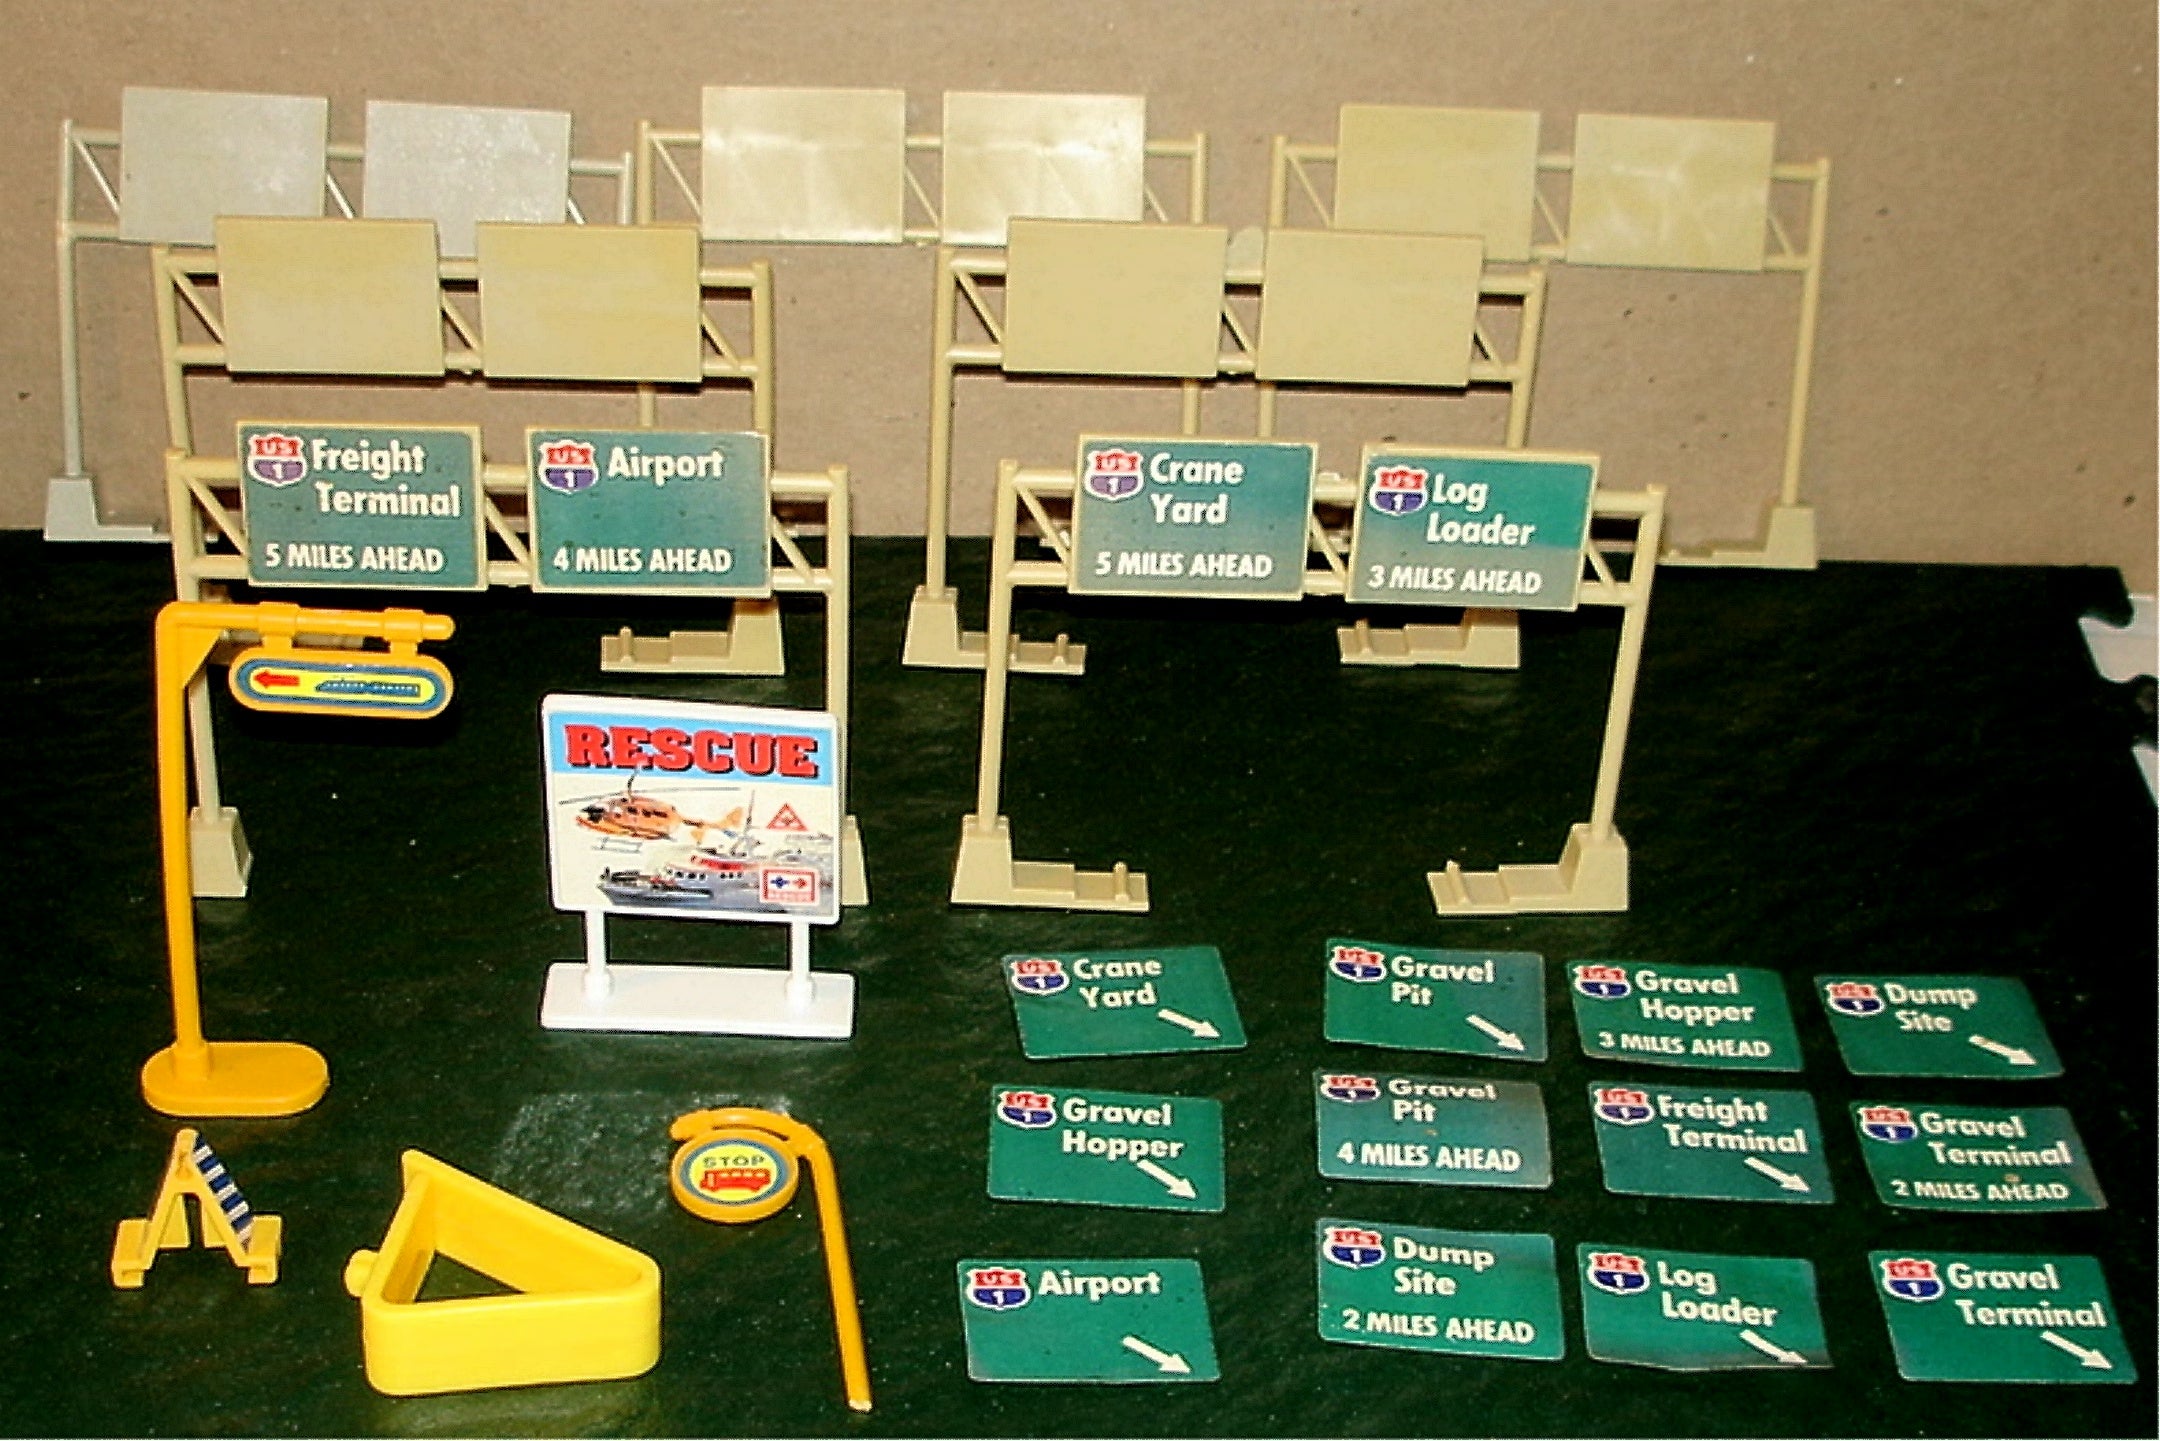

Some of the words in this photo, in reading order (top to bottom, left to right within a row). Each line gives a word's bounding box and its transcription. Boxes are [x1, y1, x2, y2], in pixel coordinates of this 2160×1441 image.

[312, 440, 427, 481] Freight
[608, 447, 724, 486] Airport
[1149, 454, 1243, 486] Crane
[316, 482, 460, 518] Terminal
[1432, 474, 1488, 512] Log
[1151, 493, 1228, 525] Yard
[1427, 514, 1535, 545] Loader
[266, 543, 281, 567] 5
[288, 545, 353, 569] MILES
[360, 548, 444, 572] AHEAD
[553, 549, 572, 570] 4
[577, 549, 642, 570] MILES
[650, 550, 732, 573] AHEAD
[1095, 551, 1111, 575] 5
[1118, 551, 1182, 577] MILES
[1188, 553, 1272, 578] AHEAD
[1369, 564, 1385, 588] 3
[1391, 566, 1454, 591] MILES
[1461, 570, 1541, 593] AHEAD
[564, 724, 819, 779] RESCUE
[1073, 958, 1162, 979] Crane
[1391, 955, 1496, 983] Gravel
[1635, 971, 1738, 994] Gravel
[1080, 983, 1156, 1008] Yard
[1391, 983, 1433, 1006] Pit
[1884, 983, 1978, 1008] Dump
[1641, 999, 1755, 1026] Hopper
[1896, 1010, 1953, 1032] Site
[1599, 1032, 1614, 1049] 3
[1621, 1033, 1686, 1054] MILES
[1692, 1039, 1770, 1058] AHEAD
[1389, 1080, 1497, 1100] Gravel
[1063, 1099, 1172, 1127] Gravel
[1393, 1100, 1436, 1122] Pit
[1658, 1095, 1767, 1127] Freight
[1661, 1123, 1808, 1154] Terminal
[1921, 1113, 2026, 1138] Gravel
[1062, 1130, 1184, 1161] Hopper
[1337, 1144, 1355, 1162] 4
[1362, 1145, 1429, 1167] MILES
[1436, 1147, 1521, 1170] AHEAD
[1928, 1141, 2072, 1167] Terminal
[703, 1155, 764, 1168] STOP
[1892, 1180, 1909, 1196] 2
[1914, 1181, 1980, 1200] MILES
[1988, 1181, 2068, 1201] AHEAD
[1394, 1236, 1495, 1270] Dump
[1038, 1270, 1159, 1301] Airport
[1393, 1268, 1457, 1295] Site
[1657, 1261, 1716, 1294] Log
[1947, 1263, 2059, 1290] Gravel
[1662, 1292, 1777, 1327] Loader
[1956, 1300, 2108, 1328] Terminal
[1343, 1309, 1361, 1330] 2
[1367, 1310, 1438, 1338] MILES
[1446, 1316, 1534, 1344] AHEAD
